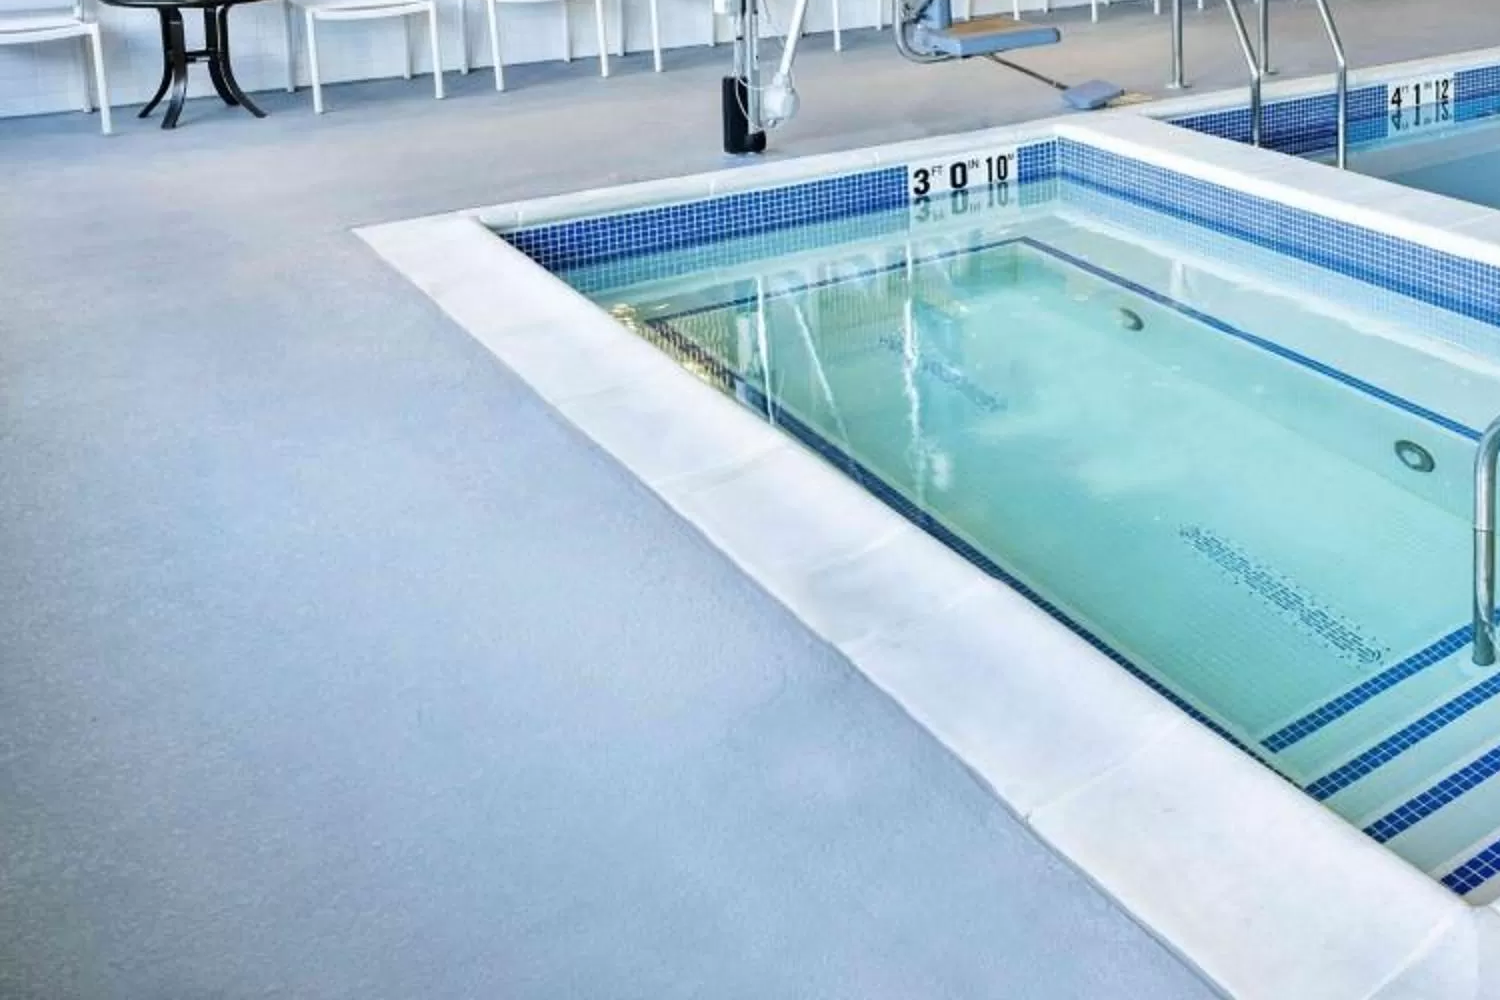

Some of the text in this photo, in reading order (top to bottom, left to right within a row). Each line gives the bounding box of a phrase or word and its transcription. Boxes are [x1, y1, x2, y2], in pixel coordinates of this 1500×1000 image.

[1391, 87, 1402, 108] 4
[913, 168, 930, 195] 3
[950, 161, 968, 189] 0
